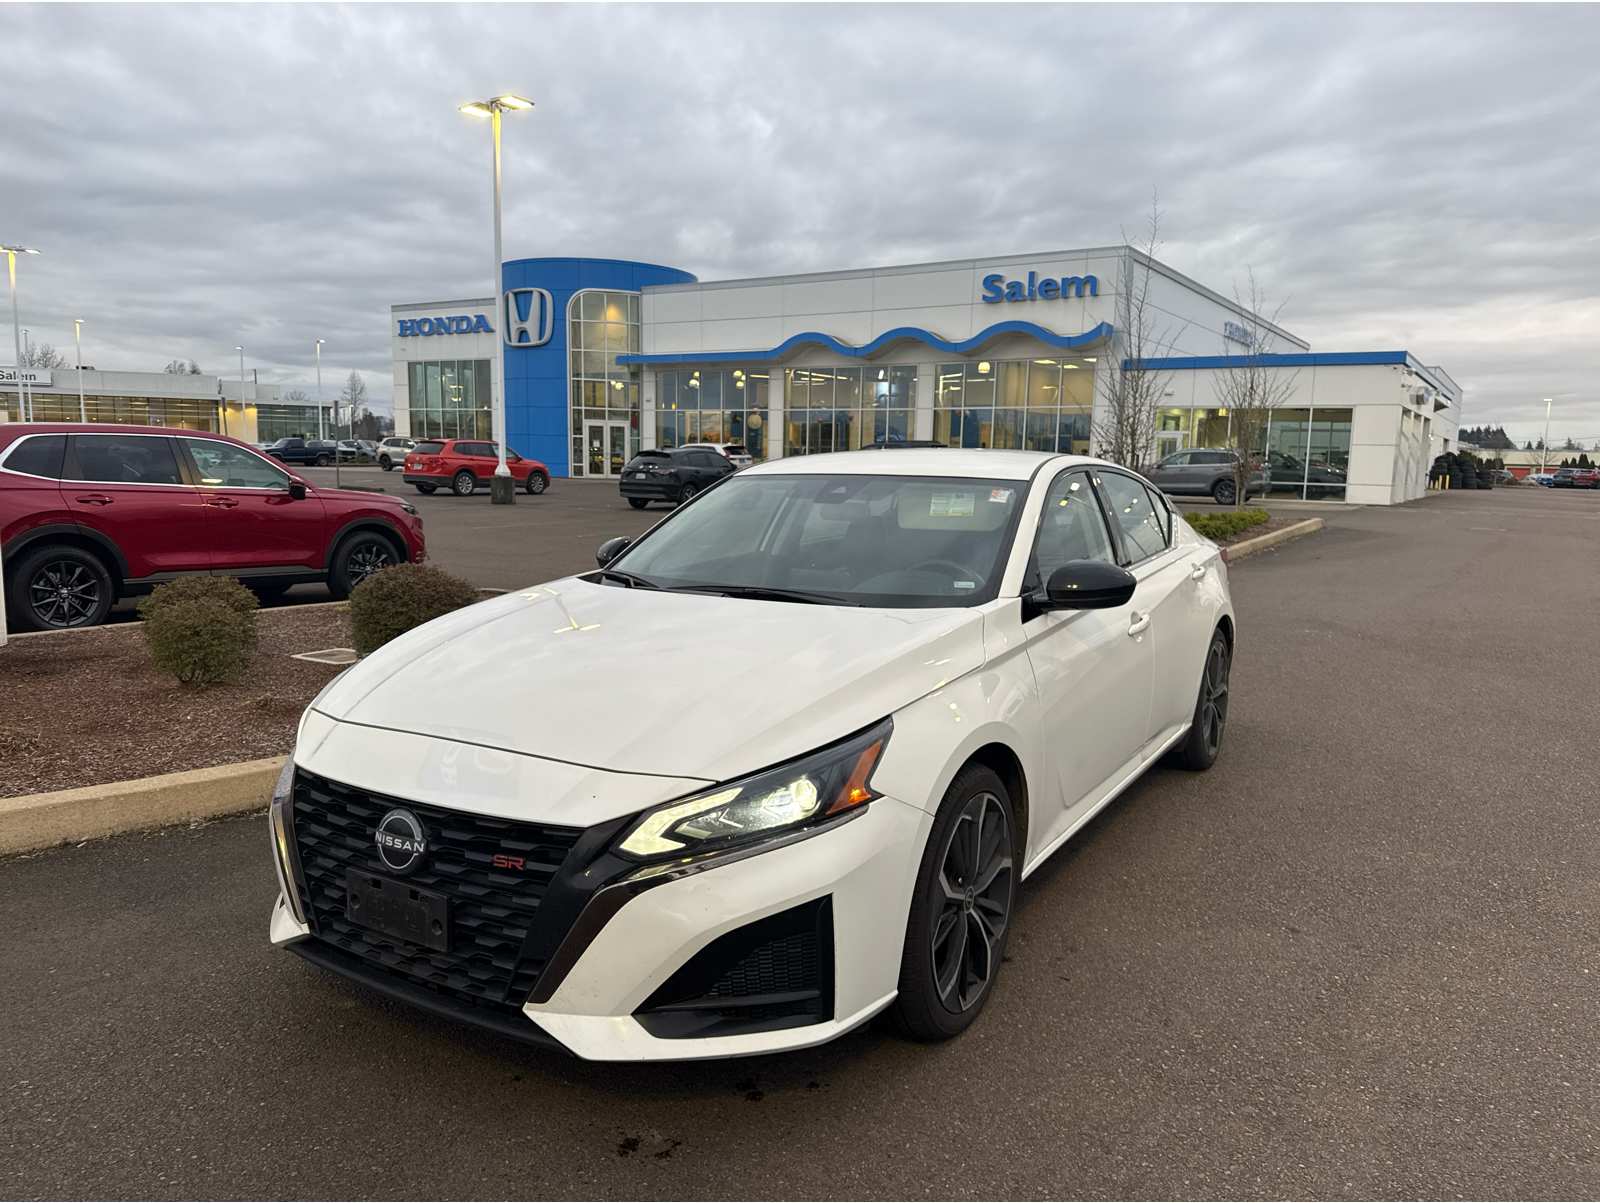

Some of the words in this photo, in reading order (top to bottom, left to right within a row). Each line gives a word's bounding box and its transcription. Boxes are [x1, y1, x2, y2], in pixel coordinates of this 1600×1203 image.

[982, 271, 1099, 304] Salem
[397, 314, 495, 337] HONDA
[375, 831, 424, 852] NISSAN
[492, 854, 524, 870] SR
